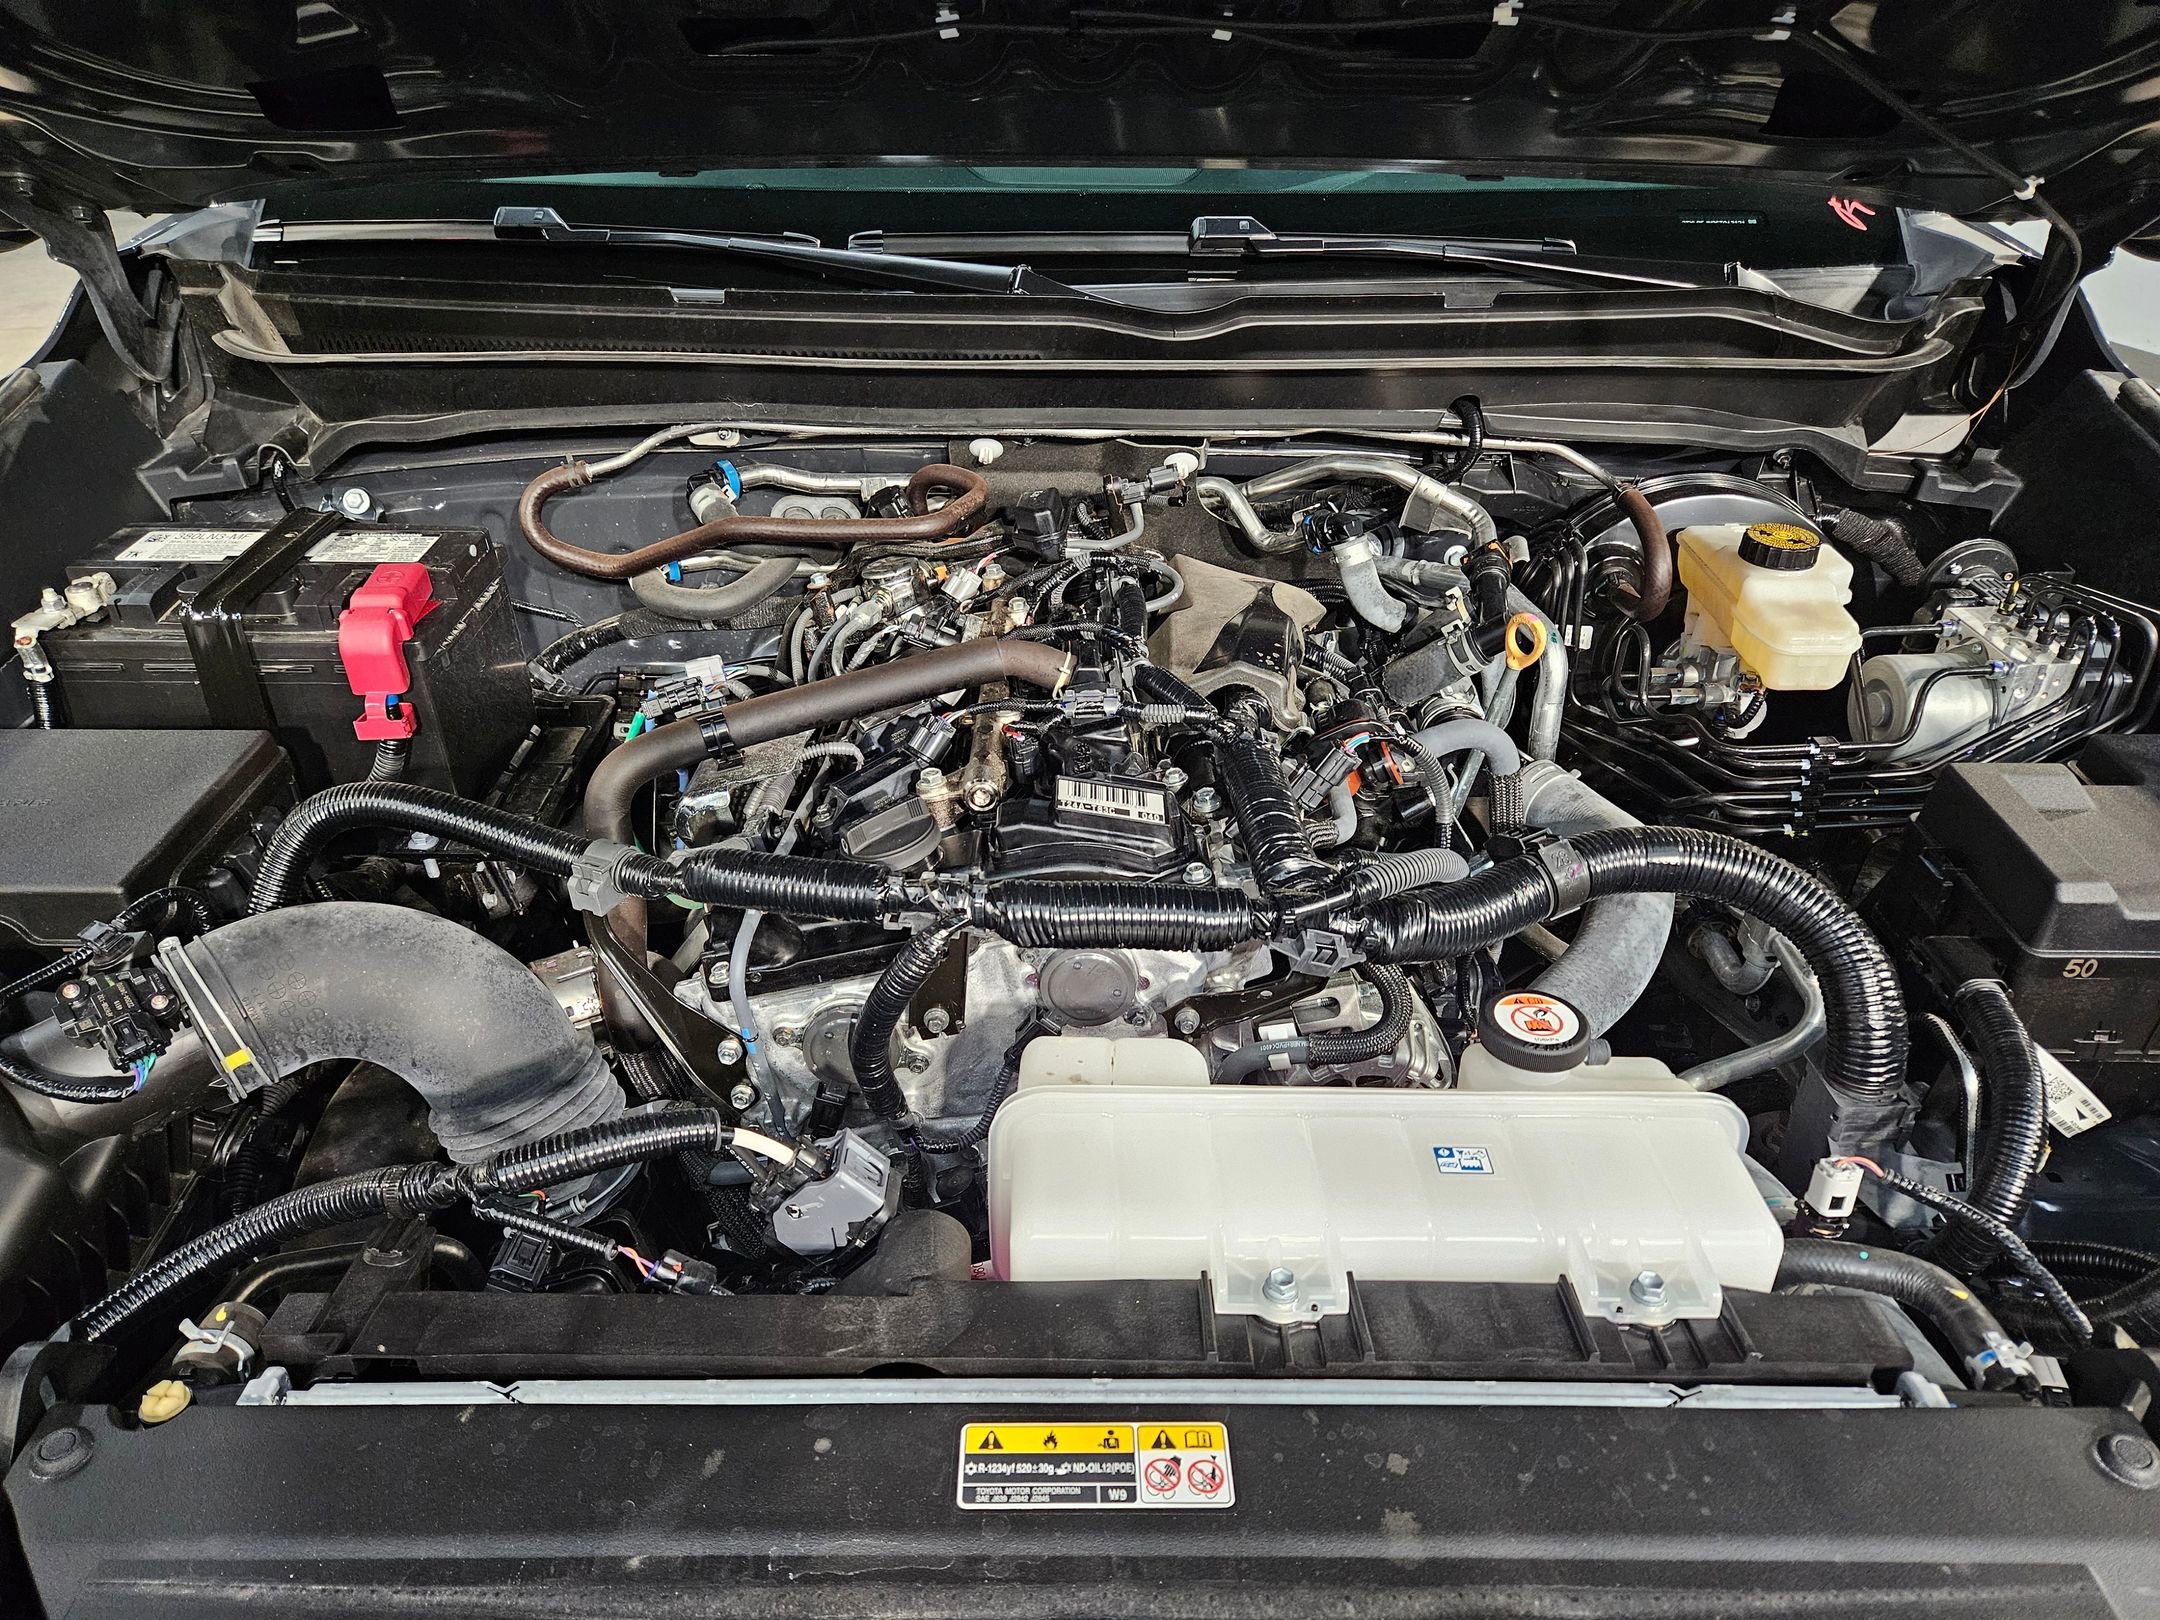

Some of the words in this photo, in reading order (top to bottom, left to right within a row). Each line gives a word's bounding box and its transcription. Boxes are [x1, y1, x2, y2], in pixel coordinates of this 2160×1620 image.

[2062, 958, 2099, 978] 50
[978, 1462, 1016, 1476] R-1234yf
[1016, 1462, 1055, 1476] 520±30g
[976, 1487, 1003, 1495] TOYOTA
[1004, 1487, 1031, 1495] MOTOR
[1031, 1487, 1082, 1495] CORPORATION
[1108, 1488, 1128, 1501] W9
